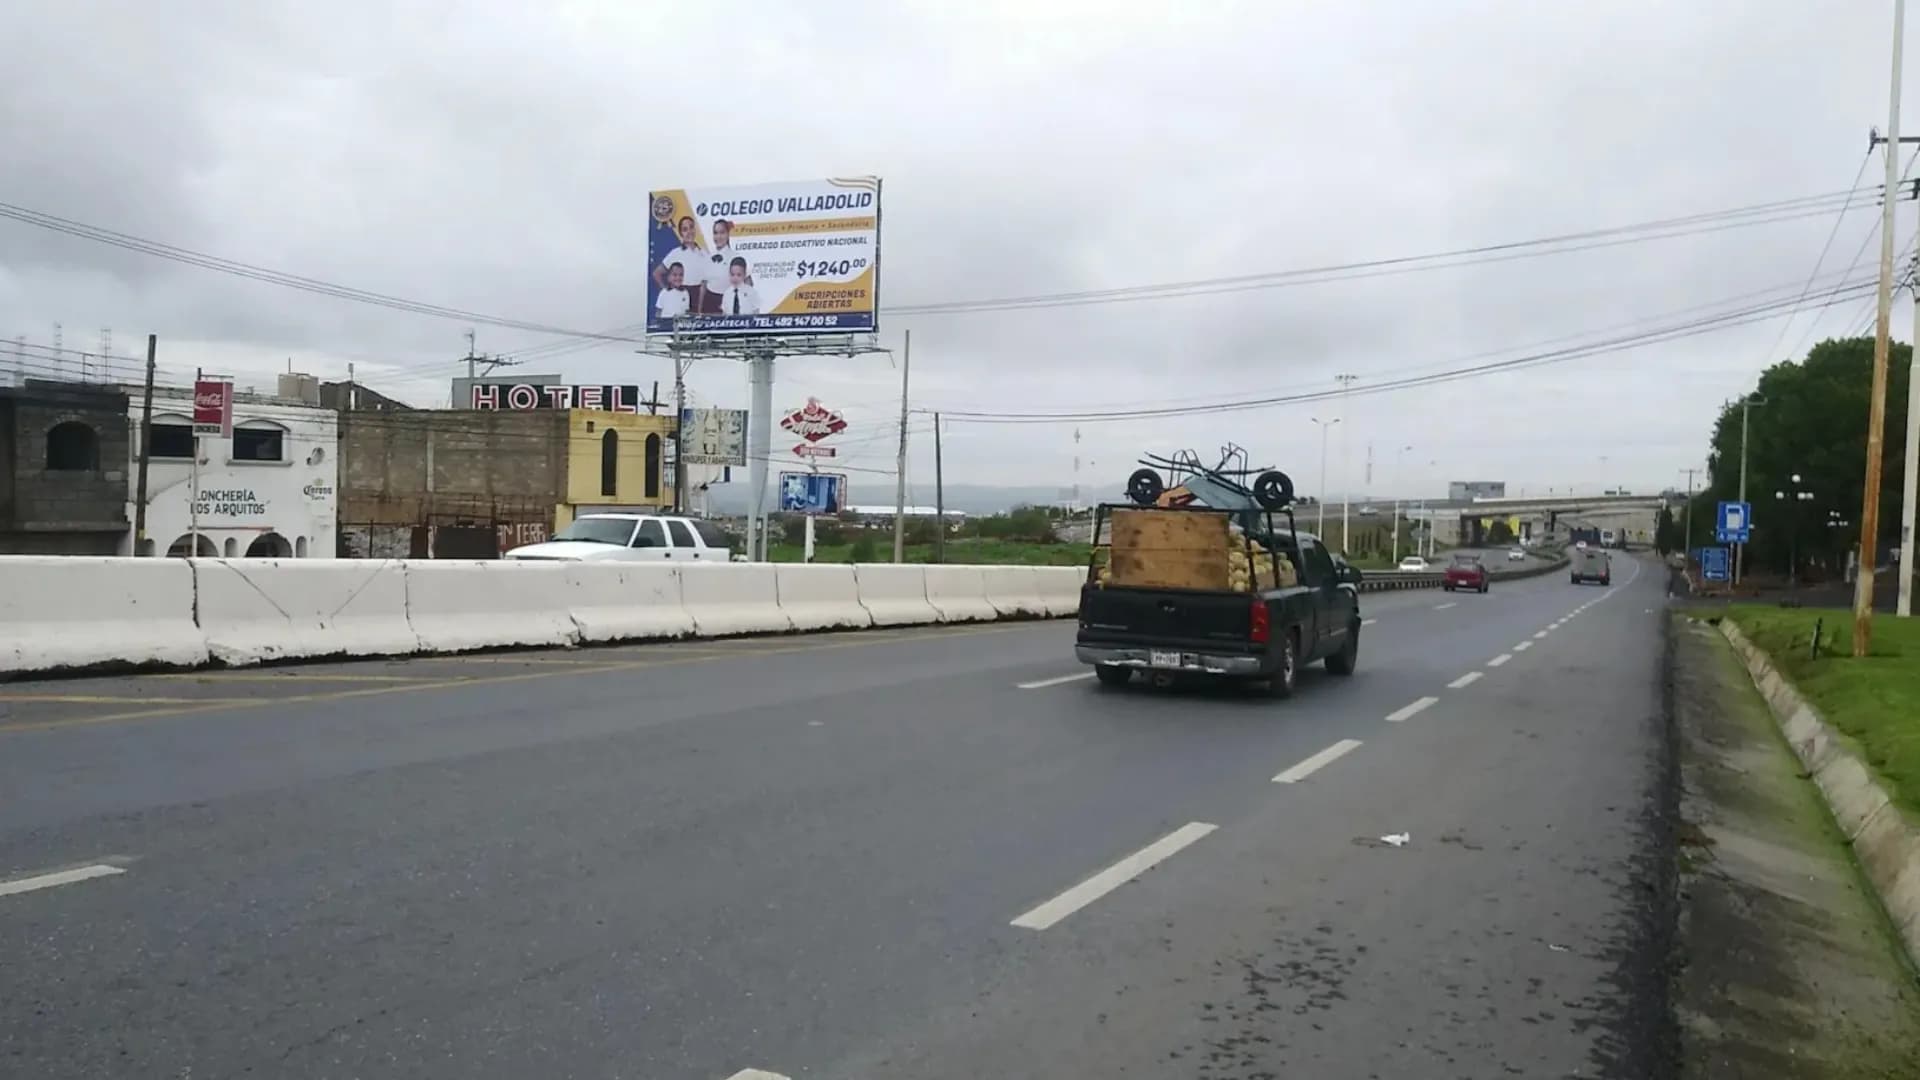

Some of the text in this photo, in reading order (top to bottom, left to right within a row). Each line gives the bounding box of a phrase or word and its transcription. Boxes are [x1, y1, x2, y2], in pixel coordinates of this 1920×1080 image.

[711, 193, 872, 216] COLEGIO VALLADOLID
[735, 237, 868, 251] LIDERAZGO EDUCATIVO NACIONAL
[795, 289, 866, 300] INSCRIPCIONES
[807, 300, 852, 309] ABIERTAS
[754, 317, 774, 328] TEL:
[824, 316, 838, 326] 52
[472, 384, 636, 413] HOTEL
[215, 503, 265, 516] ARQUITOS
